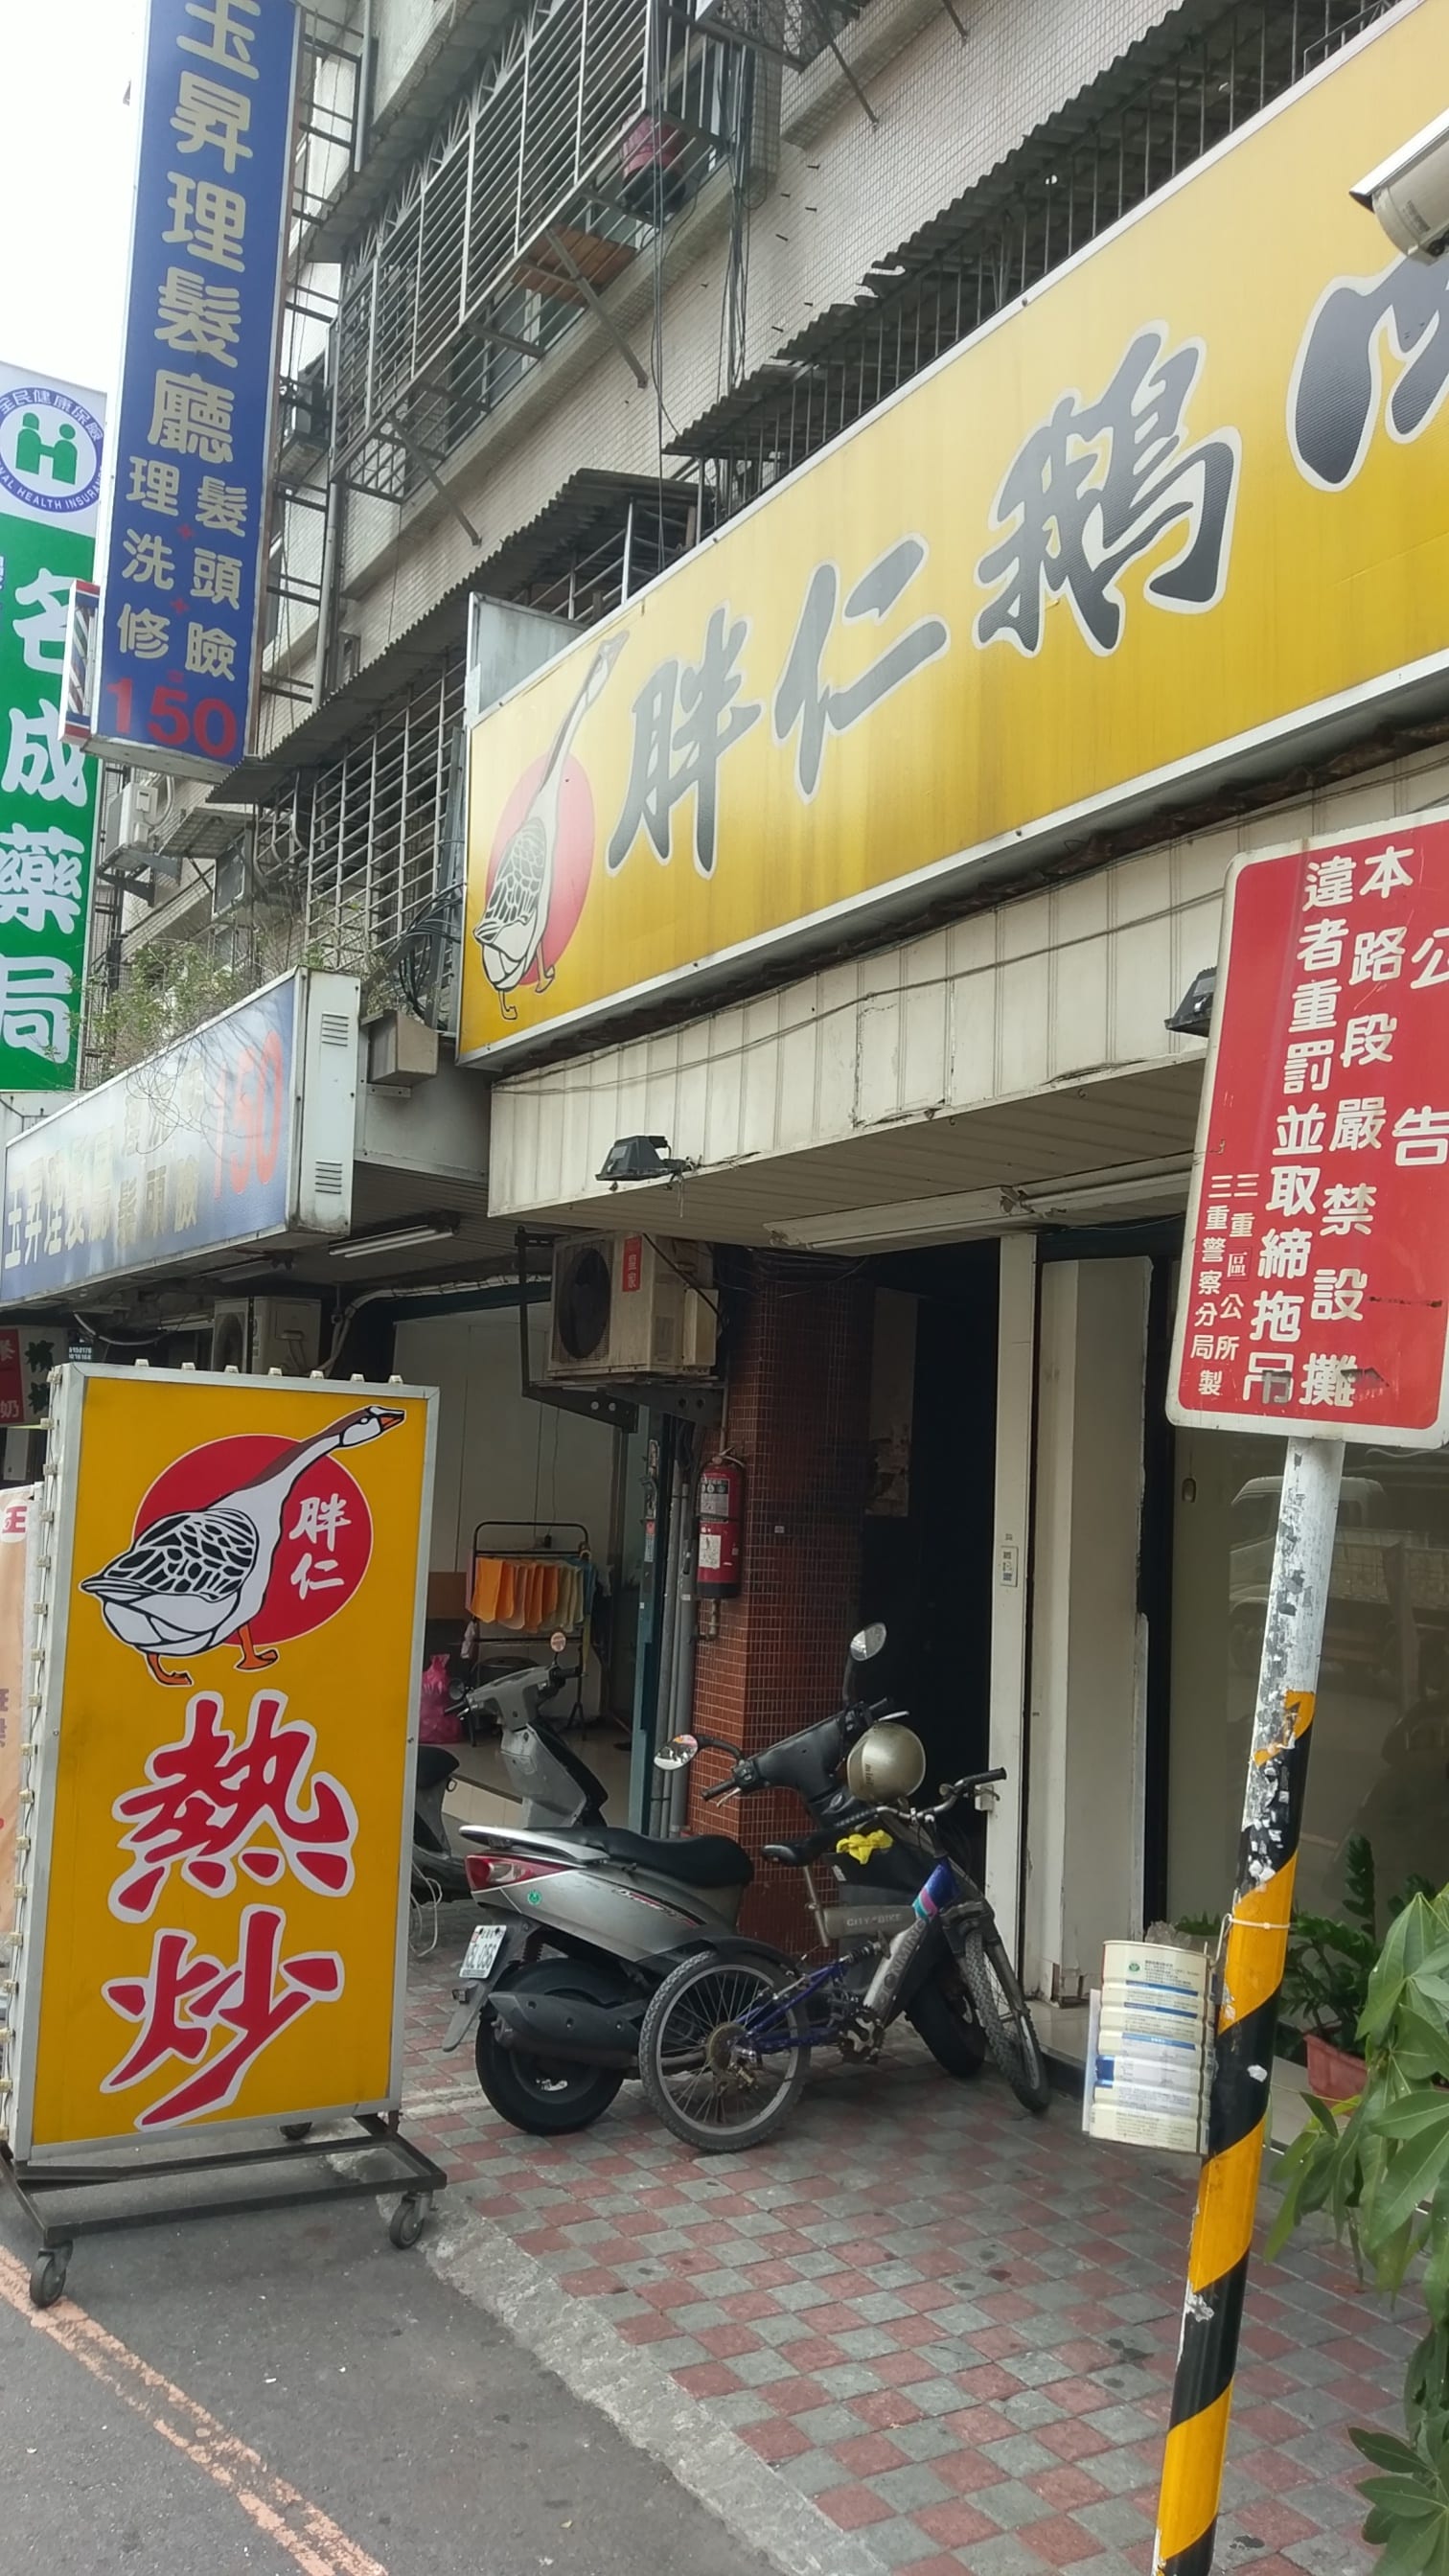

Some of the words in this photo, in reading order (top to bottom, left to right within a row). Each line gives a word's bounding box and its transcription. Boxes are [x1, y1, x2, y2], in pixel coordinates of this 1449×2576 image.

[146, 0, 261, 465] 玉昇理髮廳
[17, 487, 62, 509] HEALTH
[106, 678, 239, 758] 150
[0, 567, 88, 1065] 名成藥局
[1242, 855, 1353, 1405] 違者重罰並取締拖吊
[1300, 845, 1414, 1409] 本路段嚴禁設攤
[289, 1495, 353, 1601] 胖仁
[99, 1688, 359, 2132] 熱炒
